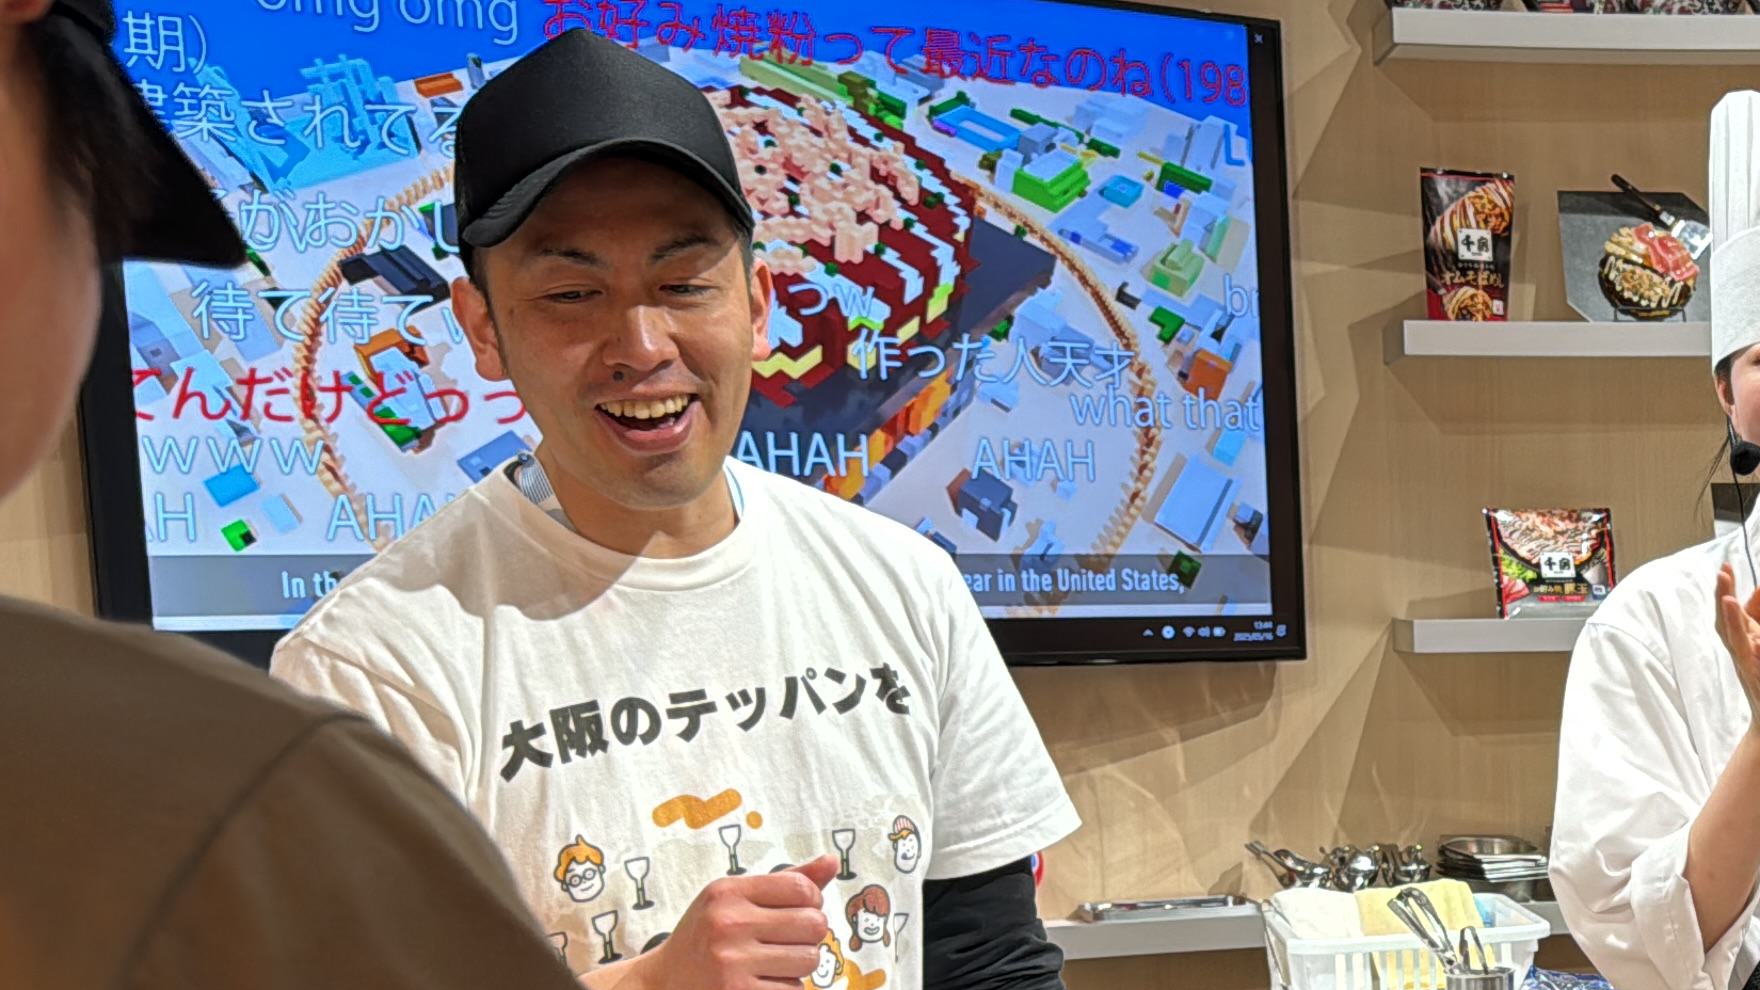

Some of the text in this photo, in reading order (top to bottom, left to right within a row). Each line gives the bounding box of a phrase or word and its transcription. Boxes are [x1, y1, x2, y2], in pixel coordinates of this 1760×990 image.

[852, 327, 1136, 388] 作った人天才
[1070, 387, 1260, 431] what that
[737, 431, 1096, 482] AHAH AHAH
[281, 570, 305, 599] In
[997, 568, 1016, 592] in
[1021, 567, 1053, 592] the
[1057, 567, 1117, 592] United
[1121, 567, 1185, 594] States,
[499, 661, 913, 783] 大阪のテッパンを
